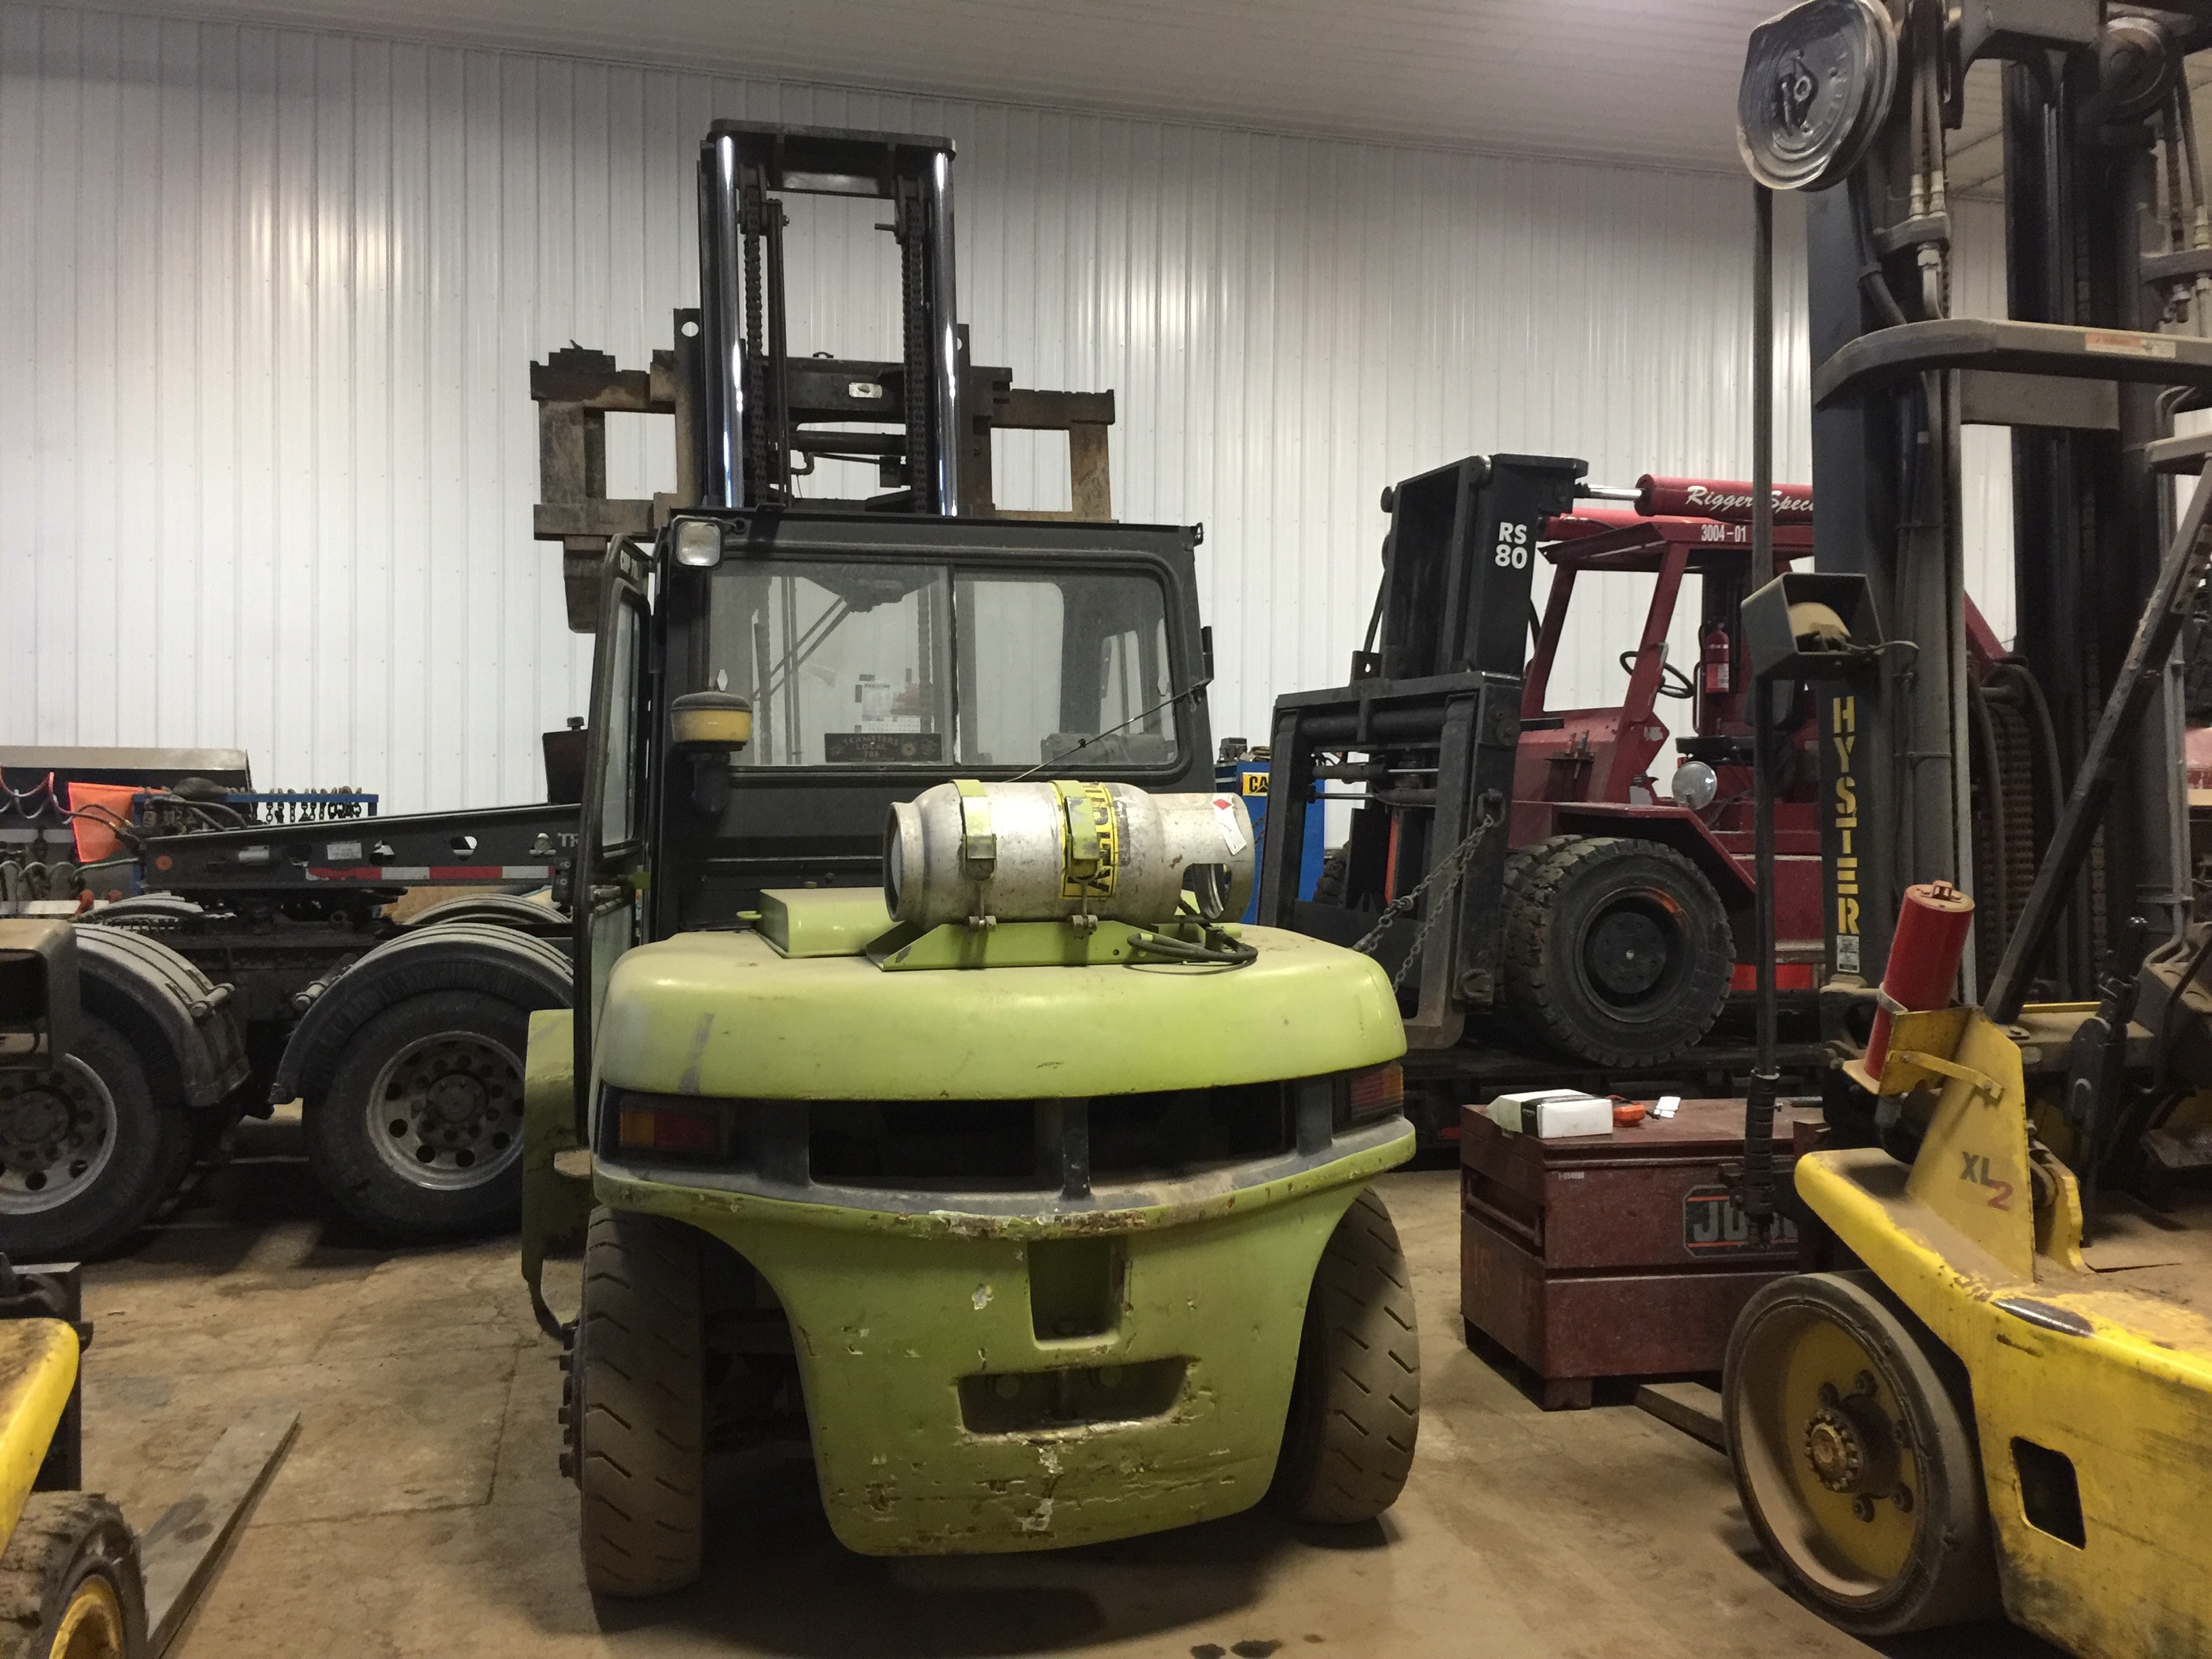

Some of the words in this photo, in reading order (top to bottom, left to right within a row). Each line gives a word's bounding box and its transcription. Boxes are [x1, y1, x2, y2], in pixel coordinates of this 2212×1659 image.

[1685, 485, 1754, 512] Rigger
[1498, 521, 1528, 545] RS
[1701, 524, 1747, 543] 3004-01
[1494, 544, 1528, 569] 80
[855, 743, 888, 751] LOCAL
[1832, 695, 1860, 935] HYSTER
